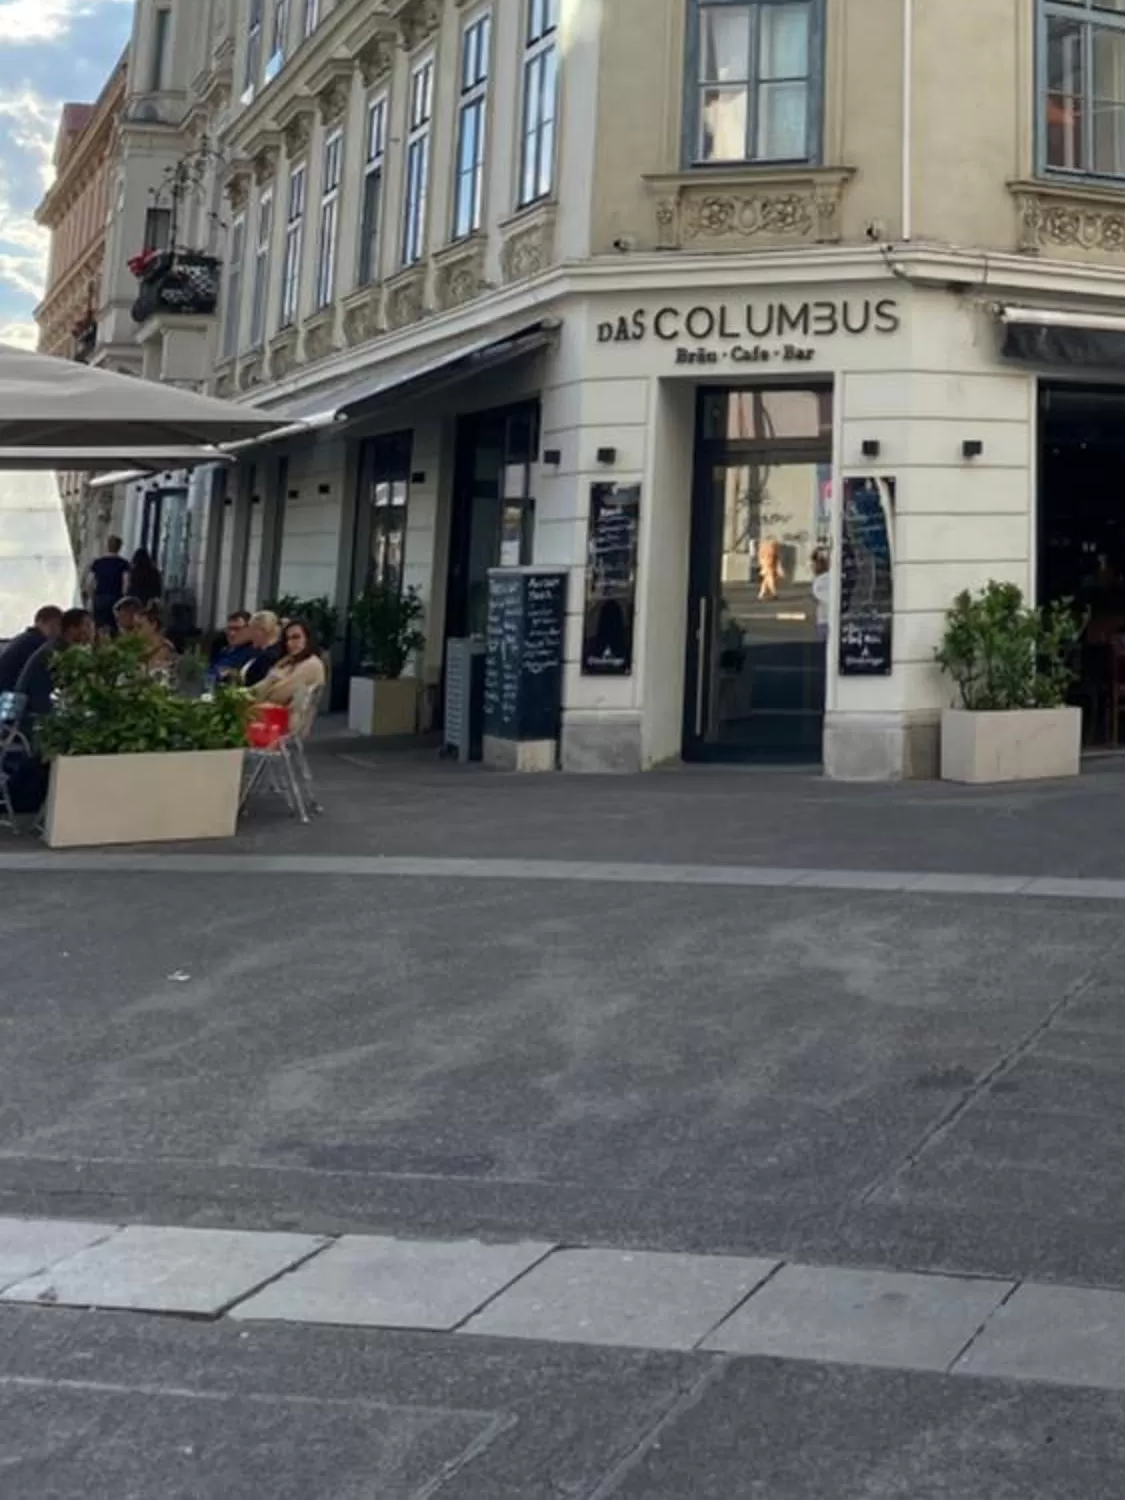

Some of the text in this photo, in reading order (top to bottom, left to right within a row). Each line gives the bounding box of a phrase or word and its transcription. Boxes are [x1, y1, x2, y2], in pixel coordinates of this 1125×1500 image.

[597, 299, 900, 342] DAS COLUMBUS
[675, 347, 717, 365] Bräu
[782, 344, 816, 361] Bar
